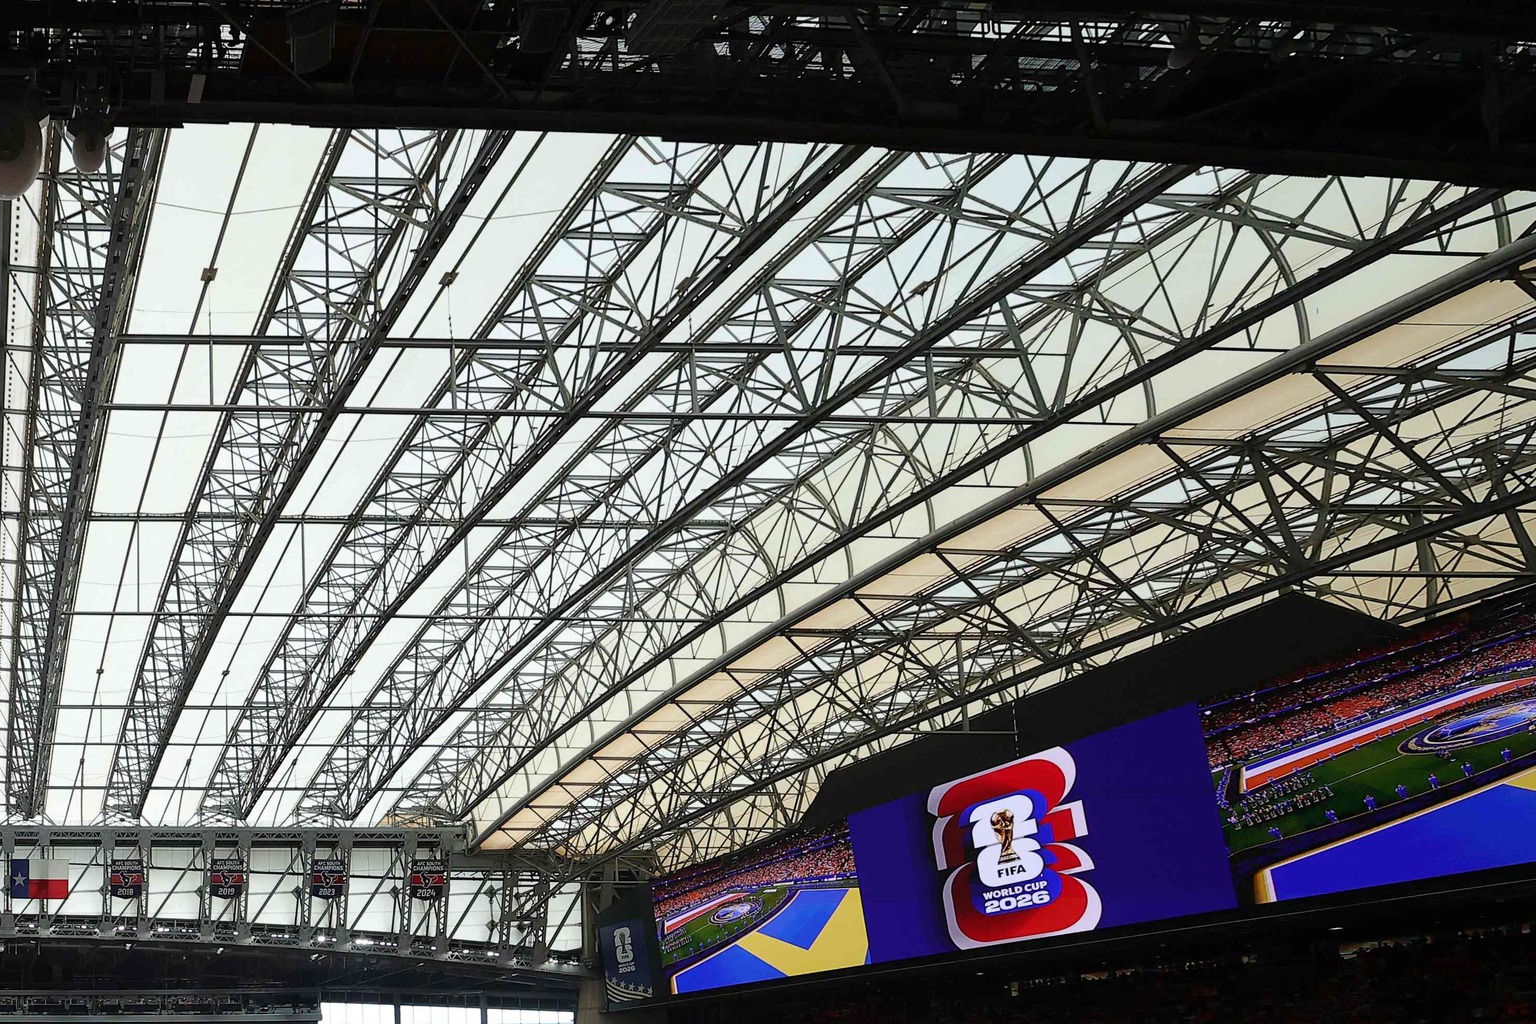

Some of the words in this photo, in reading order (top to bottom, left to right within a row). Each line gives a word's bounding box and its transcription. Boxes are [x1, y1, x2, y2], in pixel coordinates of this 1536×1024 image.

[997, 865, 1026, 878] FIFA
[117, 888, 134, 896] 2018
[218, 887, 235, 896] 2019
[318, 888, 336, 896] 2023
[417, 889, 436, 897] 2024
[983, 886, 1023, 900] WORLD
[1024, 881, 1048, 892] CUP
[984, 890, 1050, 914] 2026
[619, 965, 636, 974] 2026
